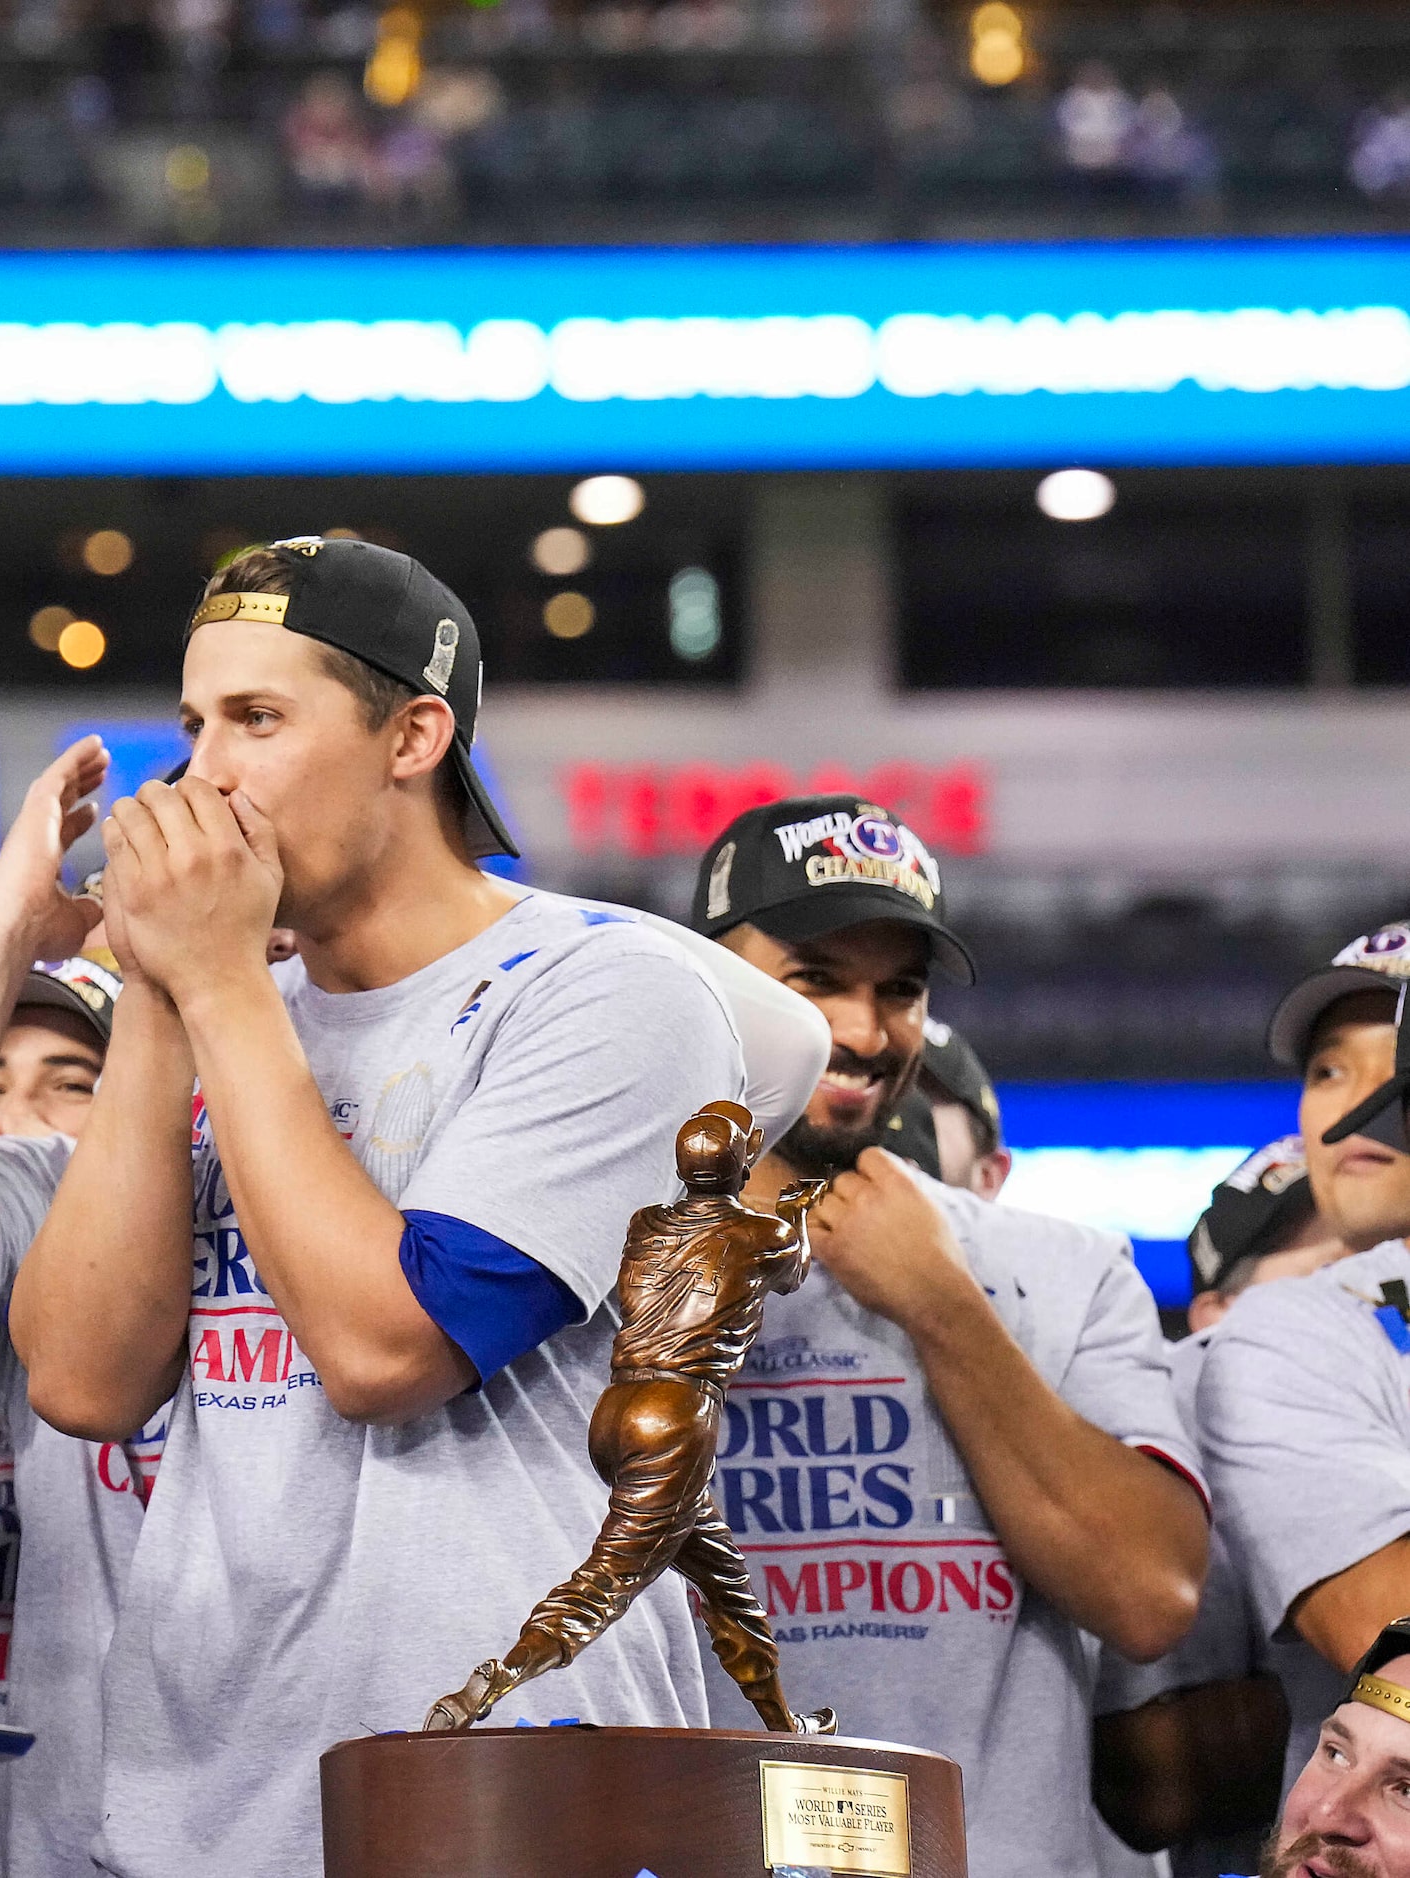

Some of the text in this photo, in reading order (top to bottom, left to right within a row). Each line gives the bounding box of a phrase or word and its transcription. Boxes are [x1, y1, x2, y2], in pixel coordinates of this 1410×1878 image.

[774, 812, 852, 863] WORLD
[710, 1464, 914, 1534] RIES
[762, 1559, 1015, 1617] MPIONS
[812, 1622, 930, 1640] RANGERS
[822, 1786, 863, 1797] WILLIE MAYS
[795, 1799, 887, 1819] WORLD SERIES
[788, 1813, 895, 1834] MOST VALUABLE PLAYER
